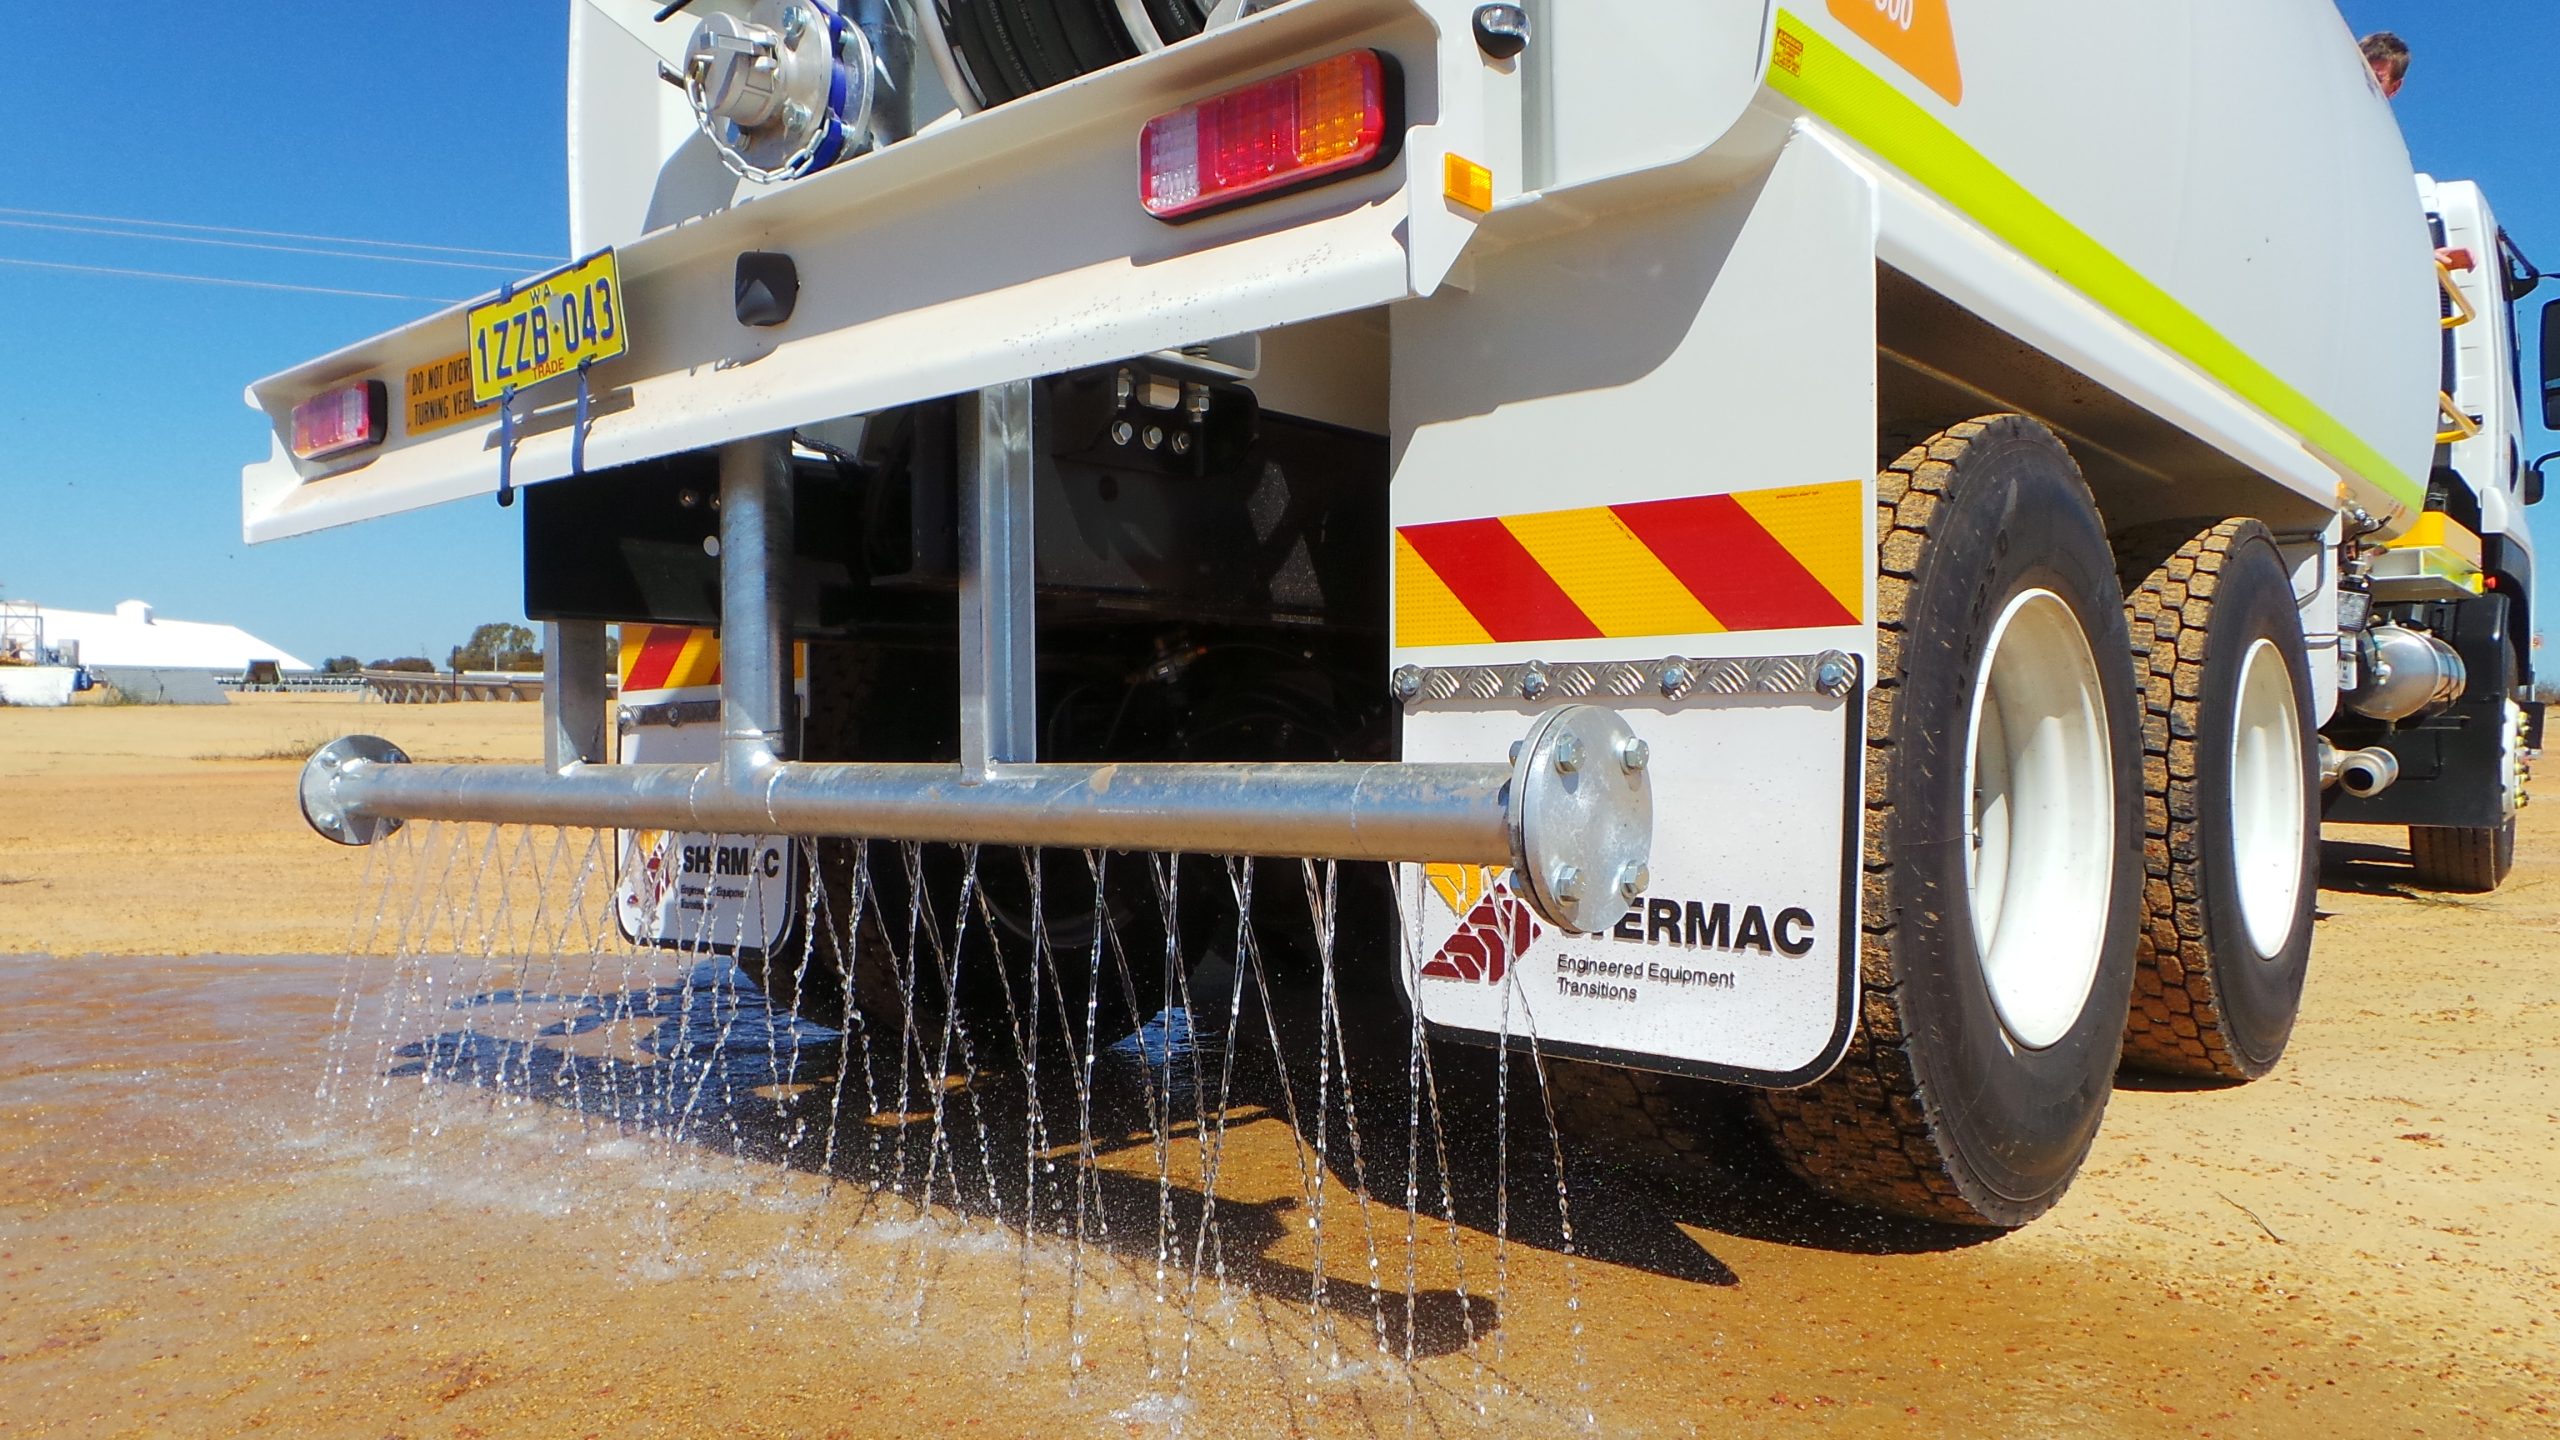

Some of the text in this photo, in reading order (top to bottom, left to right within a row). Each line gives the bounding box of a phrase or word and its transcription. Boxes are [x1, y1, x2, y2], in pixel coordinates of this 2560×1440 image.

[412, 357, 470, 396] DO NOT OVER
[532, 357, 565, 380] TRADE
[414, 394, 449, 426] TURNING
[683, 845, 780, 878] SHRMC
[1564, 896, 1816, 957] ERMAC
[1557, 953, 1736, 987] Engineered Equipment
[1557, 976, 1638, 1000] Transitions
